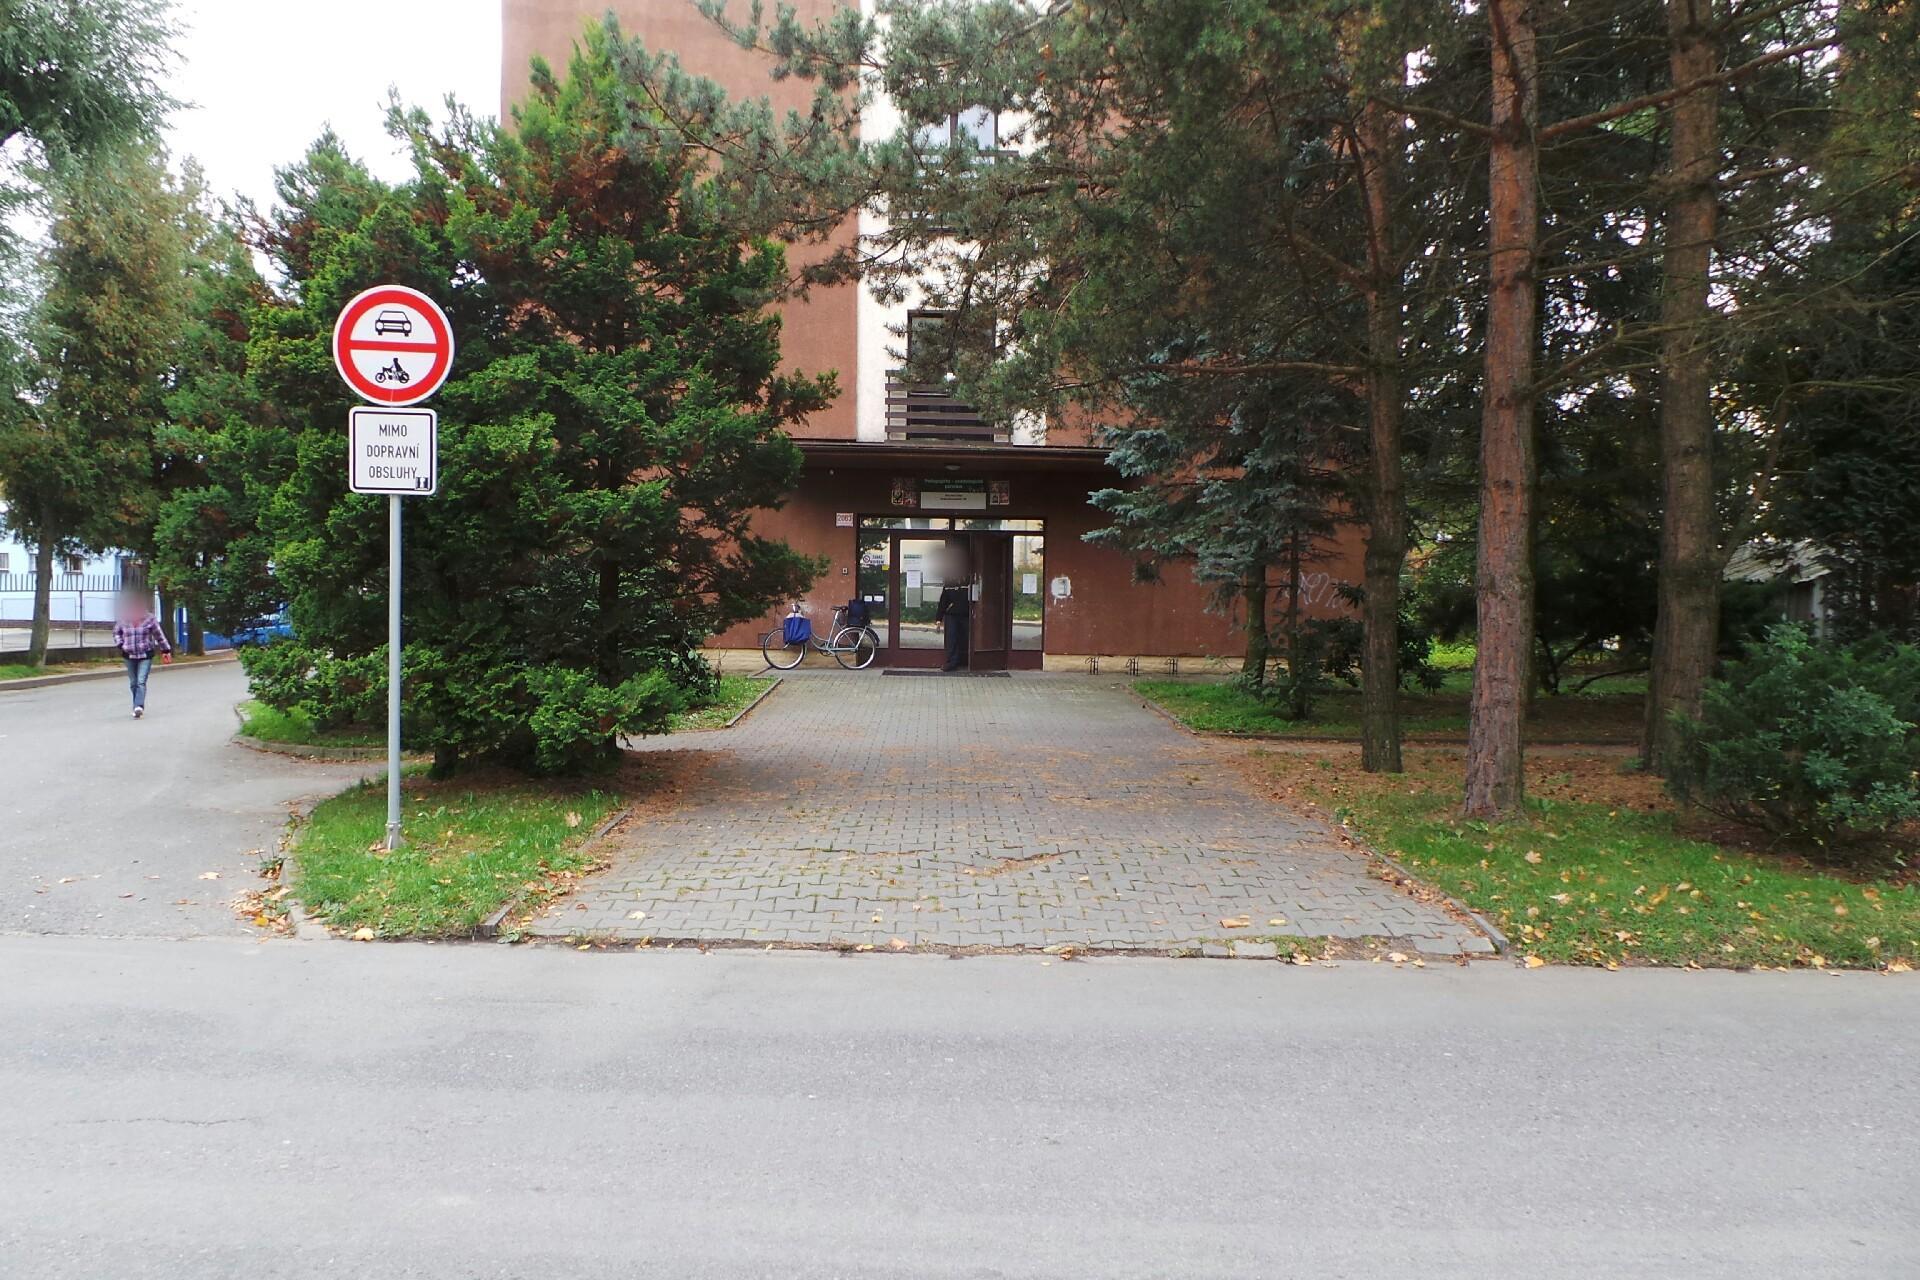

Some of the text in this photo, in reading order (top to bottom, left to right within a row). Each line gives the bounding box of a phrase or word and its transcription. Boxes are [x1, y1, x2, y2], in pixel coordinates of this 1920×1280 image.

[379, 424, 407, 437] MIMO
[366, 442, 420, 459] DOPRAVNÍ
[368, 465, 418, 479] OBSLUHY
